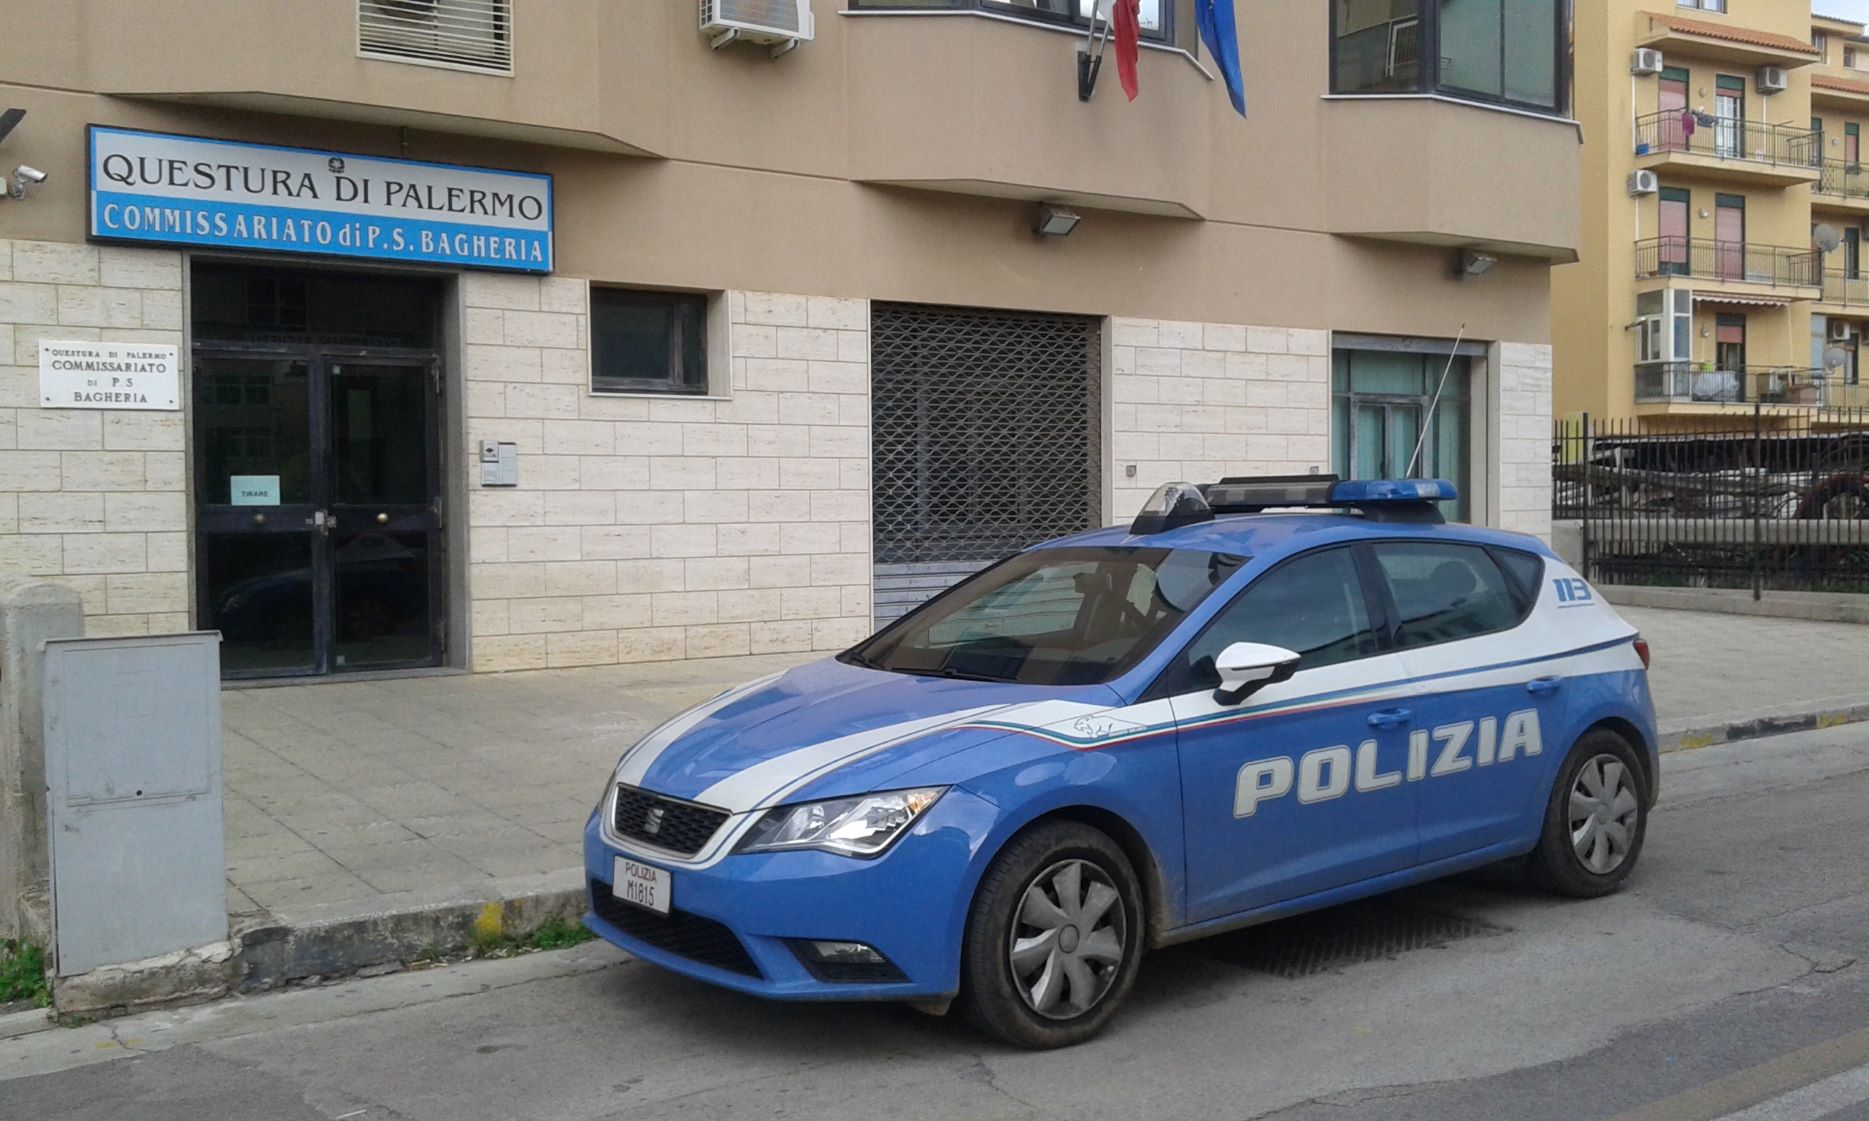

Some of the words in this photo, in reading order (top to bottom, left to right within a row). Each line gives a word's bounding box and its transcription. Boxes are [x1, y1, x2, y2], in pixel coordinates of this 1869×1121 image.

[102, 152, 318, 199] QUESTURA
[335, 175, 370, 205] DI
[384, 181, 543, 221] PALERMO
[103, 203, 332, 244] COMMISSARIATO
[420, 230, 543, 263] BAGHERIA
[52, 349, 100, 358] QUESTURA
[127, 352, 167, 360] PALERMO
[52, 360, 167, 373] COMMISSARIATO
[87, 379, 97, 387] DI
[74, 391, 148, 404] BAGHERIA
[1552, 578, 1592, 602] 113
[1233, 707, 1544, 819] POLIZIA
[626, 863, 656, 882] POLIZIA
[627, 880, 655, 905] M1815
